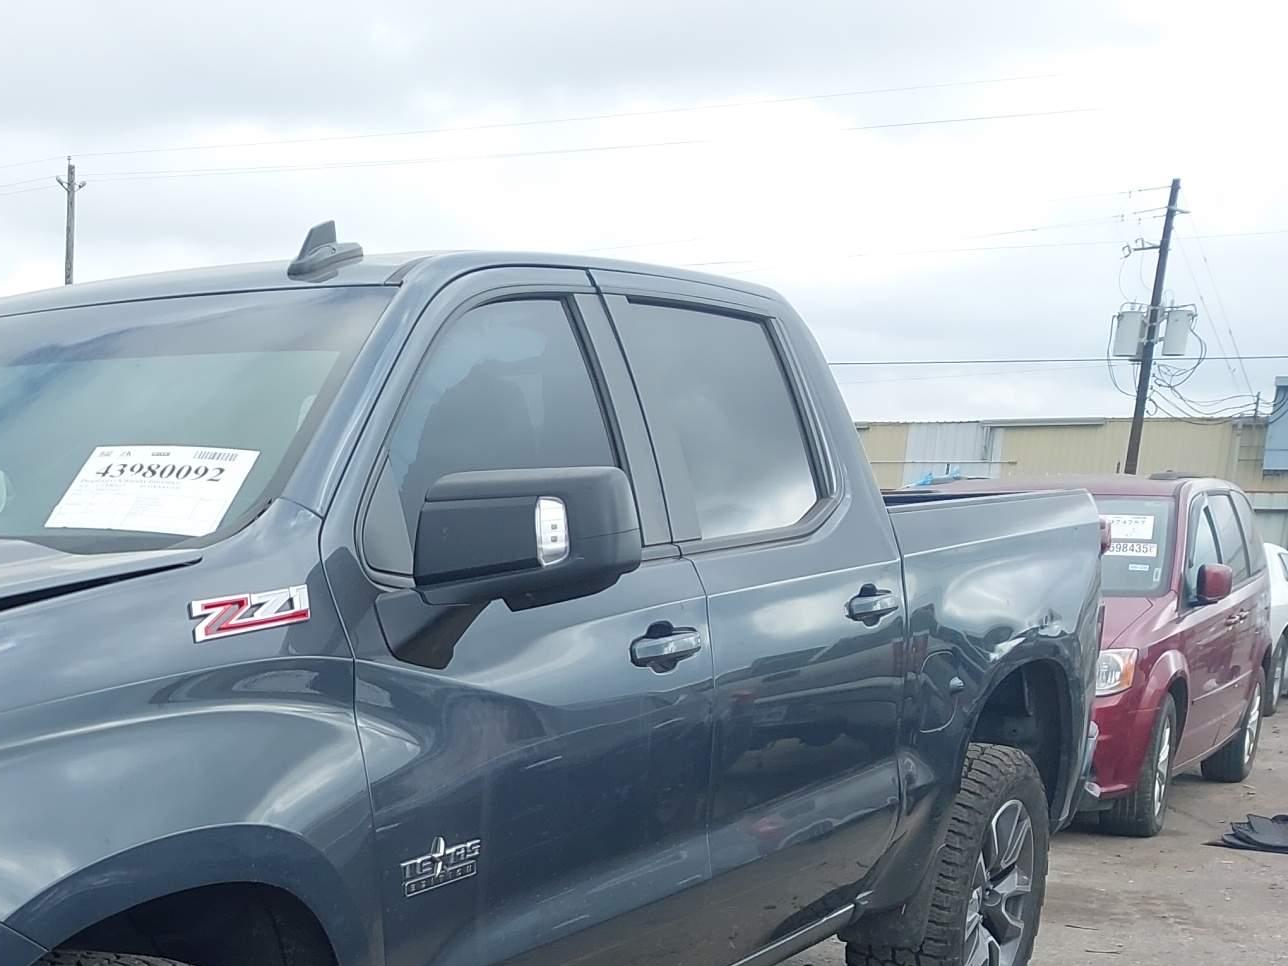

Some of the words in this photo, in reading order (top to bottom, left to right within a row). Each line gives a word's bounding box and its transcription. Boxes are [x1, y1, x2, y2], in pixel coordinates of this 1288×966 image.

[95, 463, 226, 482] 43980092
[190, 584, 311, 643] Z71
[399, 836, 481, 878] TEXAS
